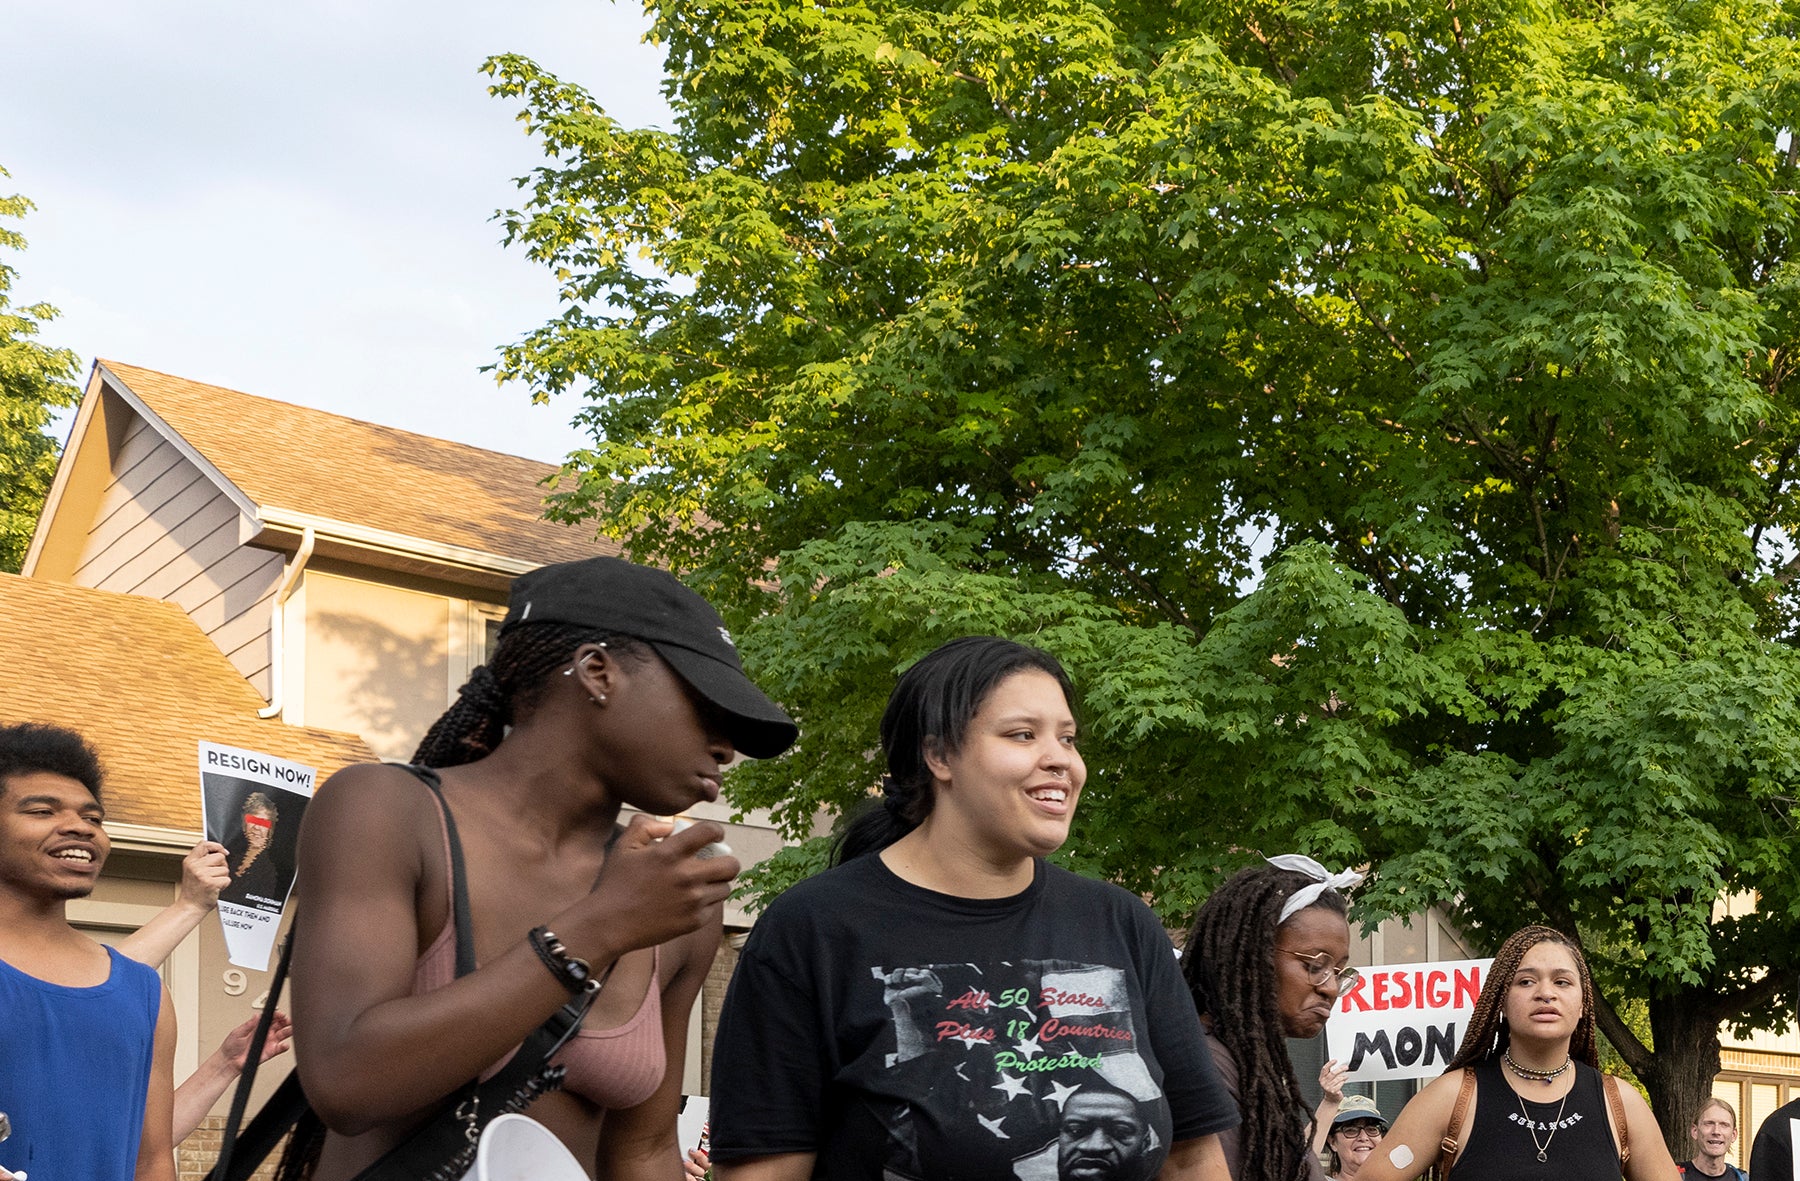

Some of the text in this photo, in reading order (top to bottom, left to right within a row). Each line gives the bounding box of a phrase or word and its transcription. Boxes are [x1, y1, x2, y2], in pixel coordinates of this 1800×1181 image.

[207, 750, 311, 788] RESIGN NOW!
[946, 990, 991, 1010] All
[997, 987, 1030, 1008] 50
[1341, 966, 1481, 1013] RESIGN
[934, 1018, 1132, 1042] Plus 18 Countries
[994, 1051, 1102, 1073] Protested
[1348, 1022, 1456, 1071] MON
